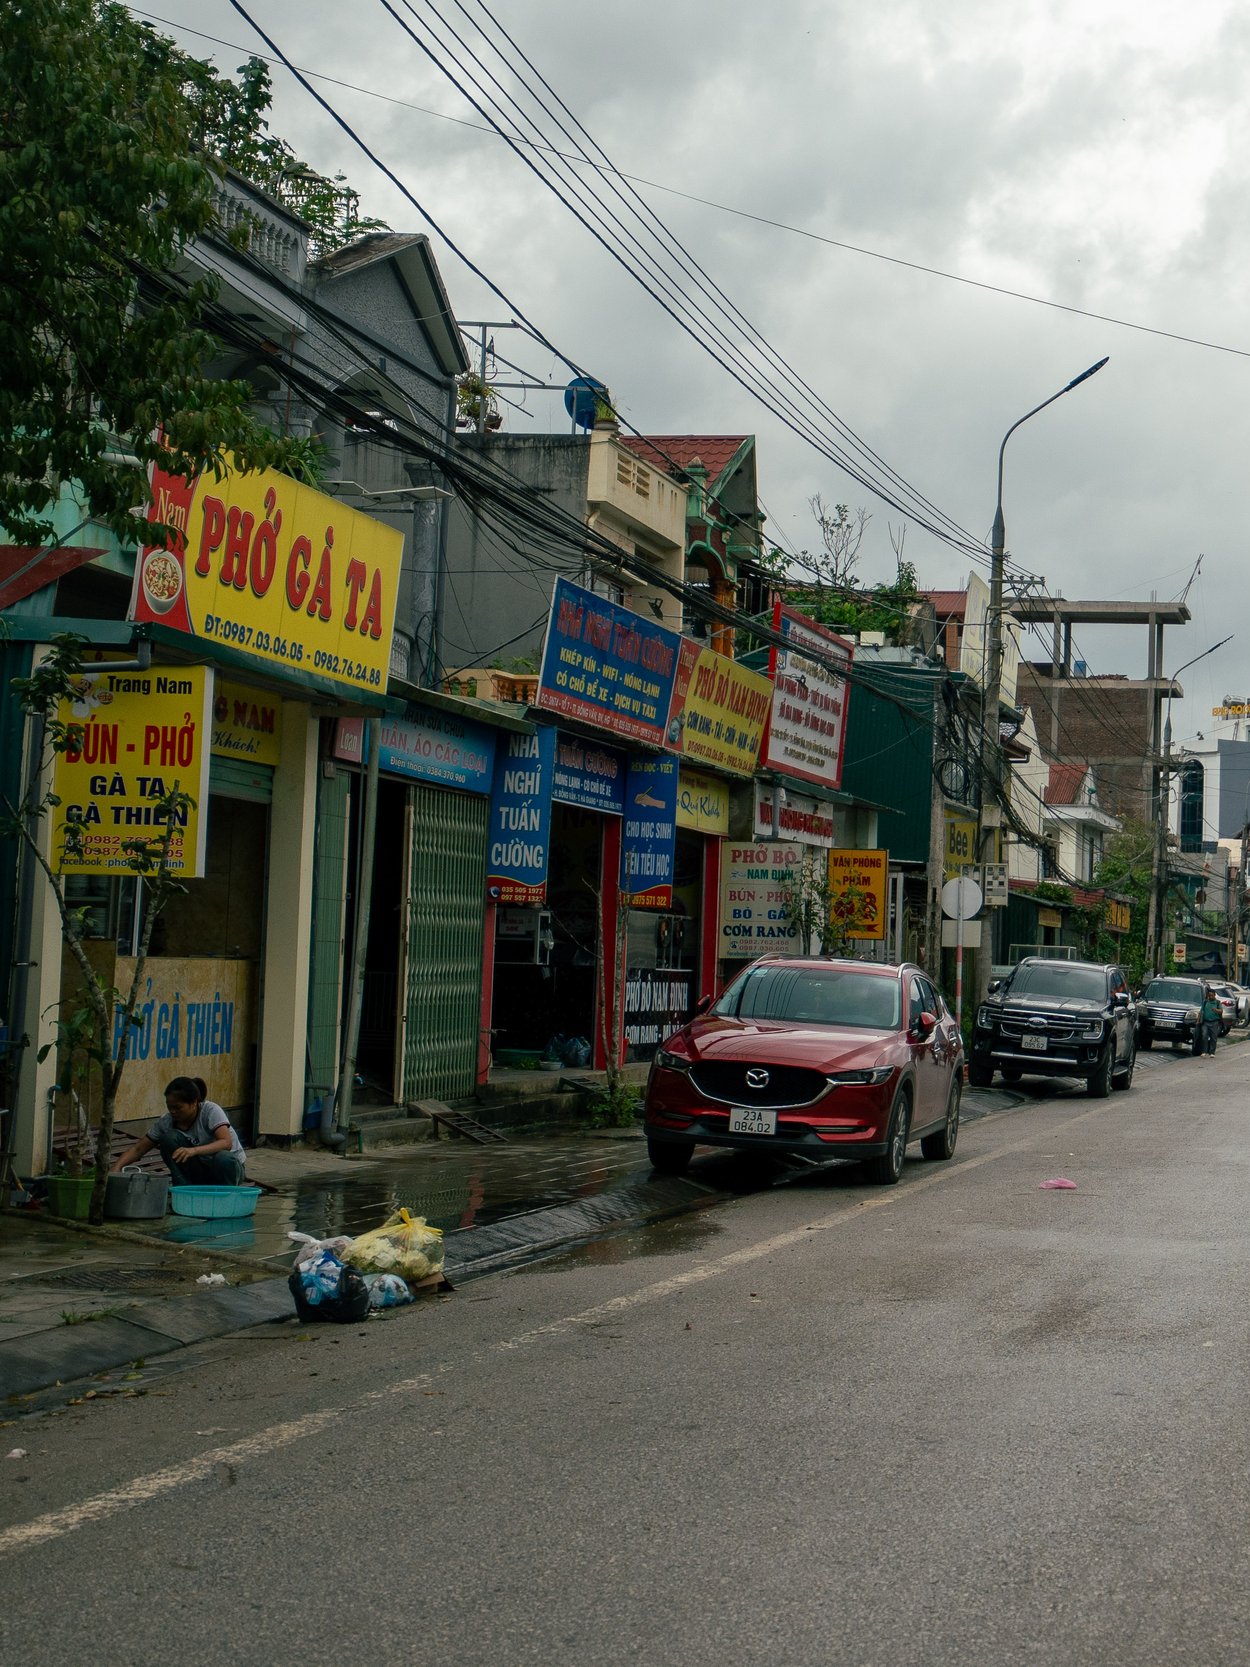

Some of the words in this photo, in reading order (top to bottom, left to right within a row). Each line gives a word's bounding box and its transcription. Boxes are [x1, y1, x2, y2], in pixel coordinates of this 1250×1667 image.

[155, 487, 187, 531] Nam
[195, 486, 283, 597] PHỞ
[286, 525, 333, 622] GÀ
[344, 557, 383, 640] TA
[313, 648, 382, 686] 0982.76.24.88
[560, 646, 582, 666] KHÉP
[602, 663, 619, 682] WIFI
[108, 675, 151, 694] Trang
[156, 677, 193, 695] Nam
[556, 668, 568, 687] CÓ
[598, 686, 608, 703] XE
[641, 702, 657, 719] TAXI
[693, 657, 719, 702] PHỞ
[727, 679, 750, 715] NAM
[233, 699, 276, 734] NAM
[143, 712, 196, 767] PHỞ
[508, 731, 540, 759] NHÀ
[435, 740, 460, 767] CÁC
[462, 751, 488, 778] LOẠI
[90, 772, 126, 797] GÀ
[136, 776, 166, 797] TA
[504, 764, 542, 796] NGHỈ
[499, 800, 540, 832] TUẤN
[626, 820, 640, 838] CHO
[640, 822, 655, 842] HỌC
[655, 823, 672, 840] SINH
[491, 838, 544, 868] CƯỜNG
[640, 844, 654, 877] TIỂU
[654, 853, 670, 881] HỌC
[731, 844, 768, 864] PHỞ
[772, 847, 797, 864] BÒ
[833, 856, 850, 868] VĂN
[853, 856, 882, 868] PHÒNG
[747, 868, 770, 880] NAM
[729, 887, 756, 902] BÚN
[732, 906, 752, 919] BÒ
[767, 908, 787, 920] GÀ
[723, 923, 753, 937] CƠM
[756, 926, 797, 938] RANG
[625, 969, 641, 1012] PHỞ
[640, 973, 652, 1012] BÒ
[652, 982, 669, 1012] NAM
[669, 982, 688, 1018] ĐỊNH
[156, 992, 180, 1060] GÀ
[625, 1024, 641, 1045] CƠM
[640, 1024, 658, 1044] RANG
[733, 1121, 771, 1133] 084.02
[743, 1111, 763, 1121] 23A
